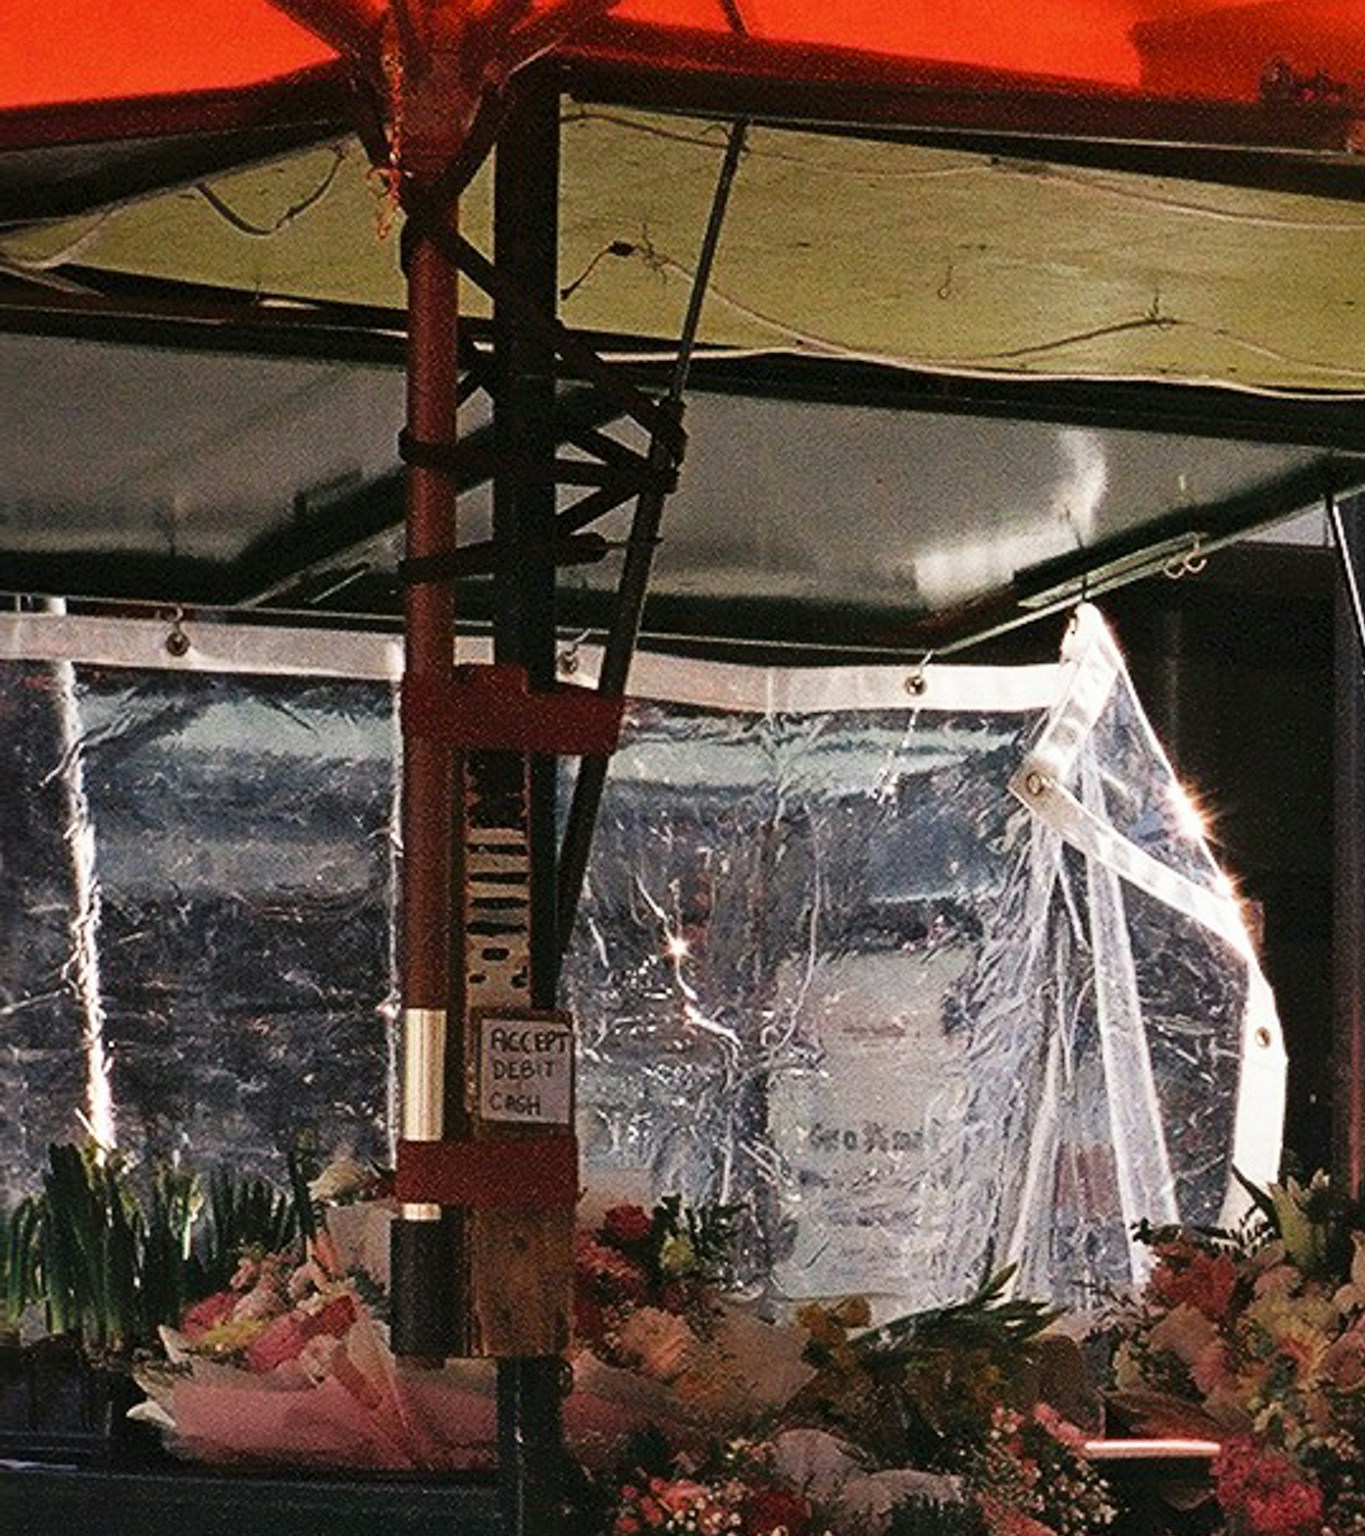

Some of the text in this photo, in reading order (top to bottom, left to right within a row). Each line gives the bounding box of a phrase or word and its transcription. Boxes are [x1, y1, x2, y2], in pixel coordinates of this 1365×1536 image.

[490, 1027, 572, 1054] ACCEPT
[493, 1060, 554, 1081] DEBIT
[489, 1092, 541, 1115] CASH
